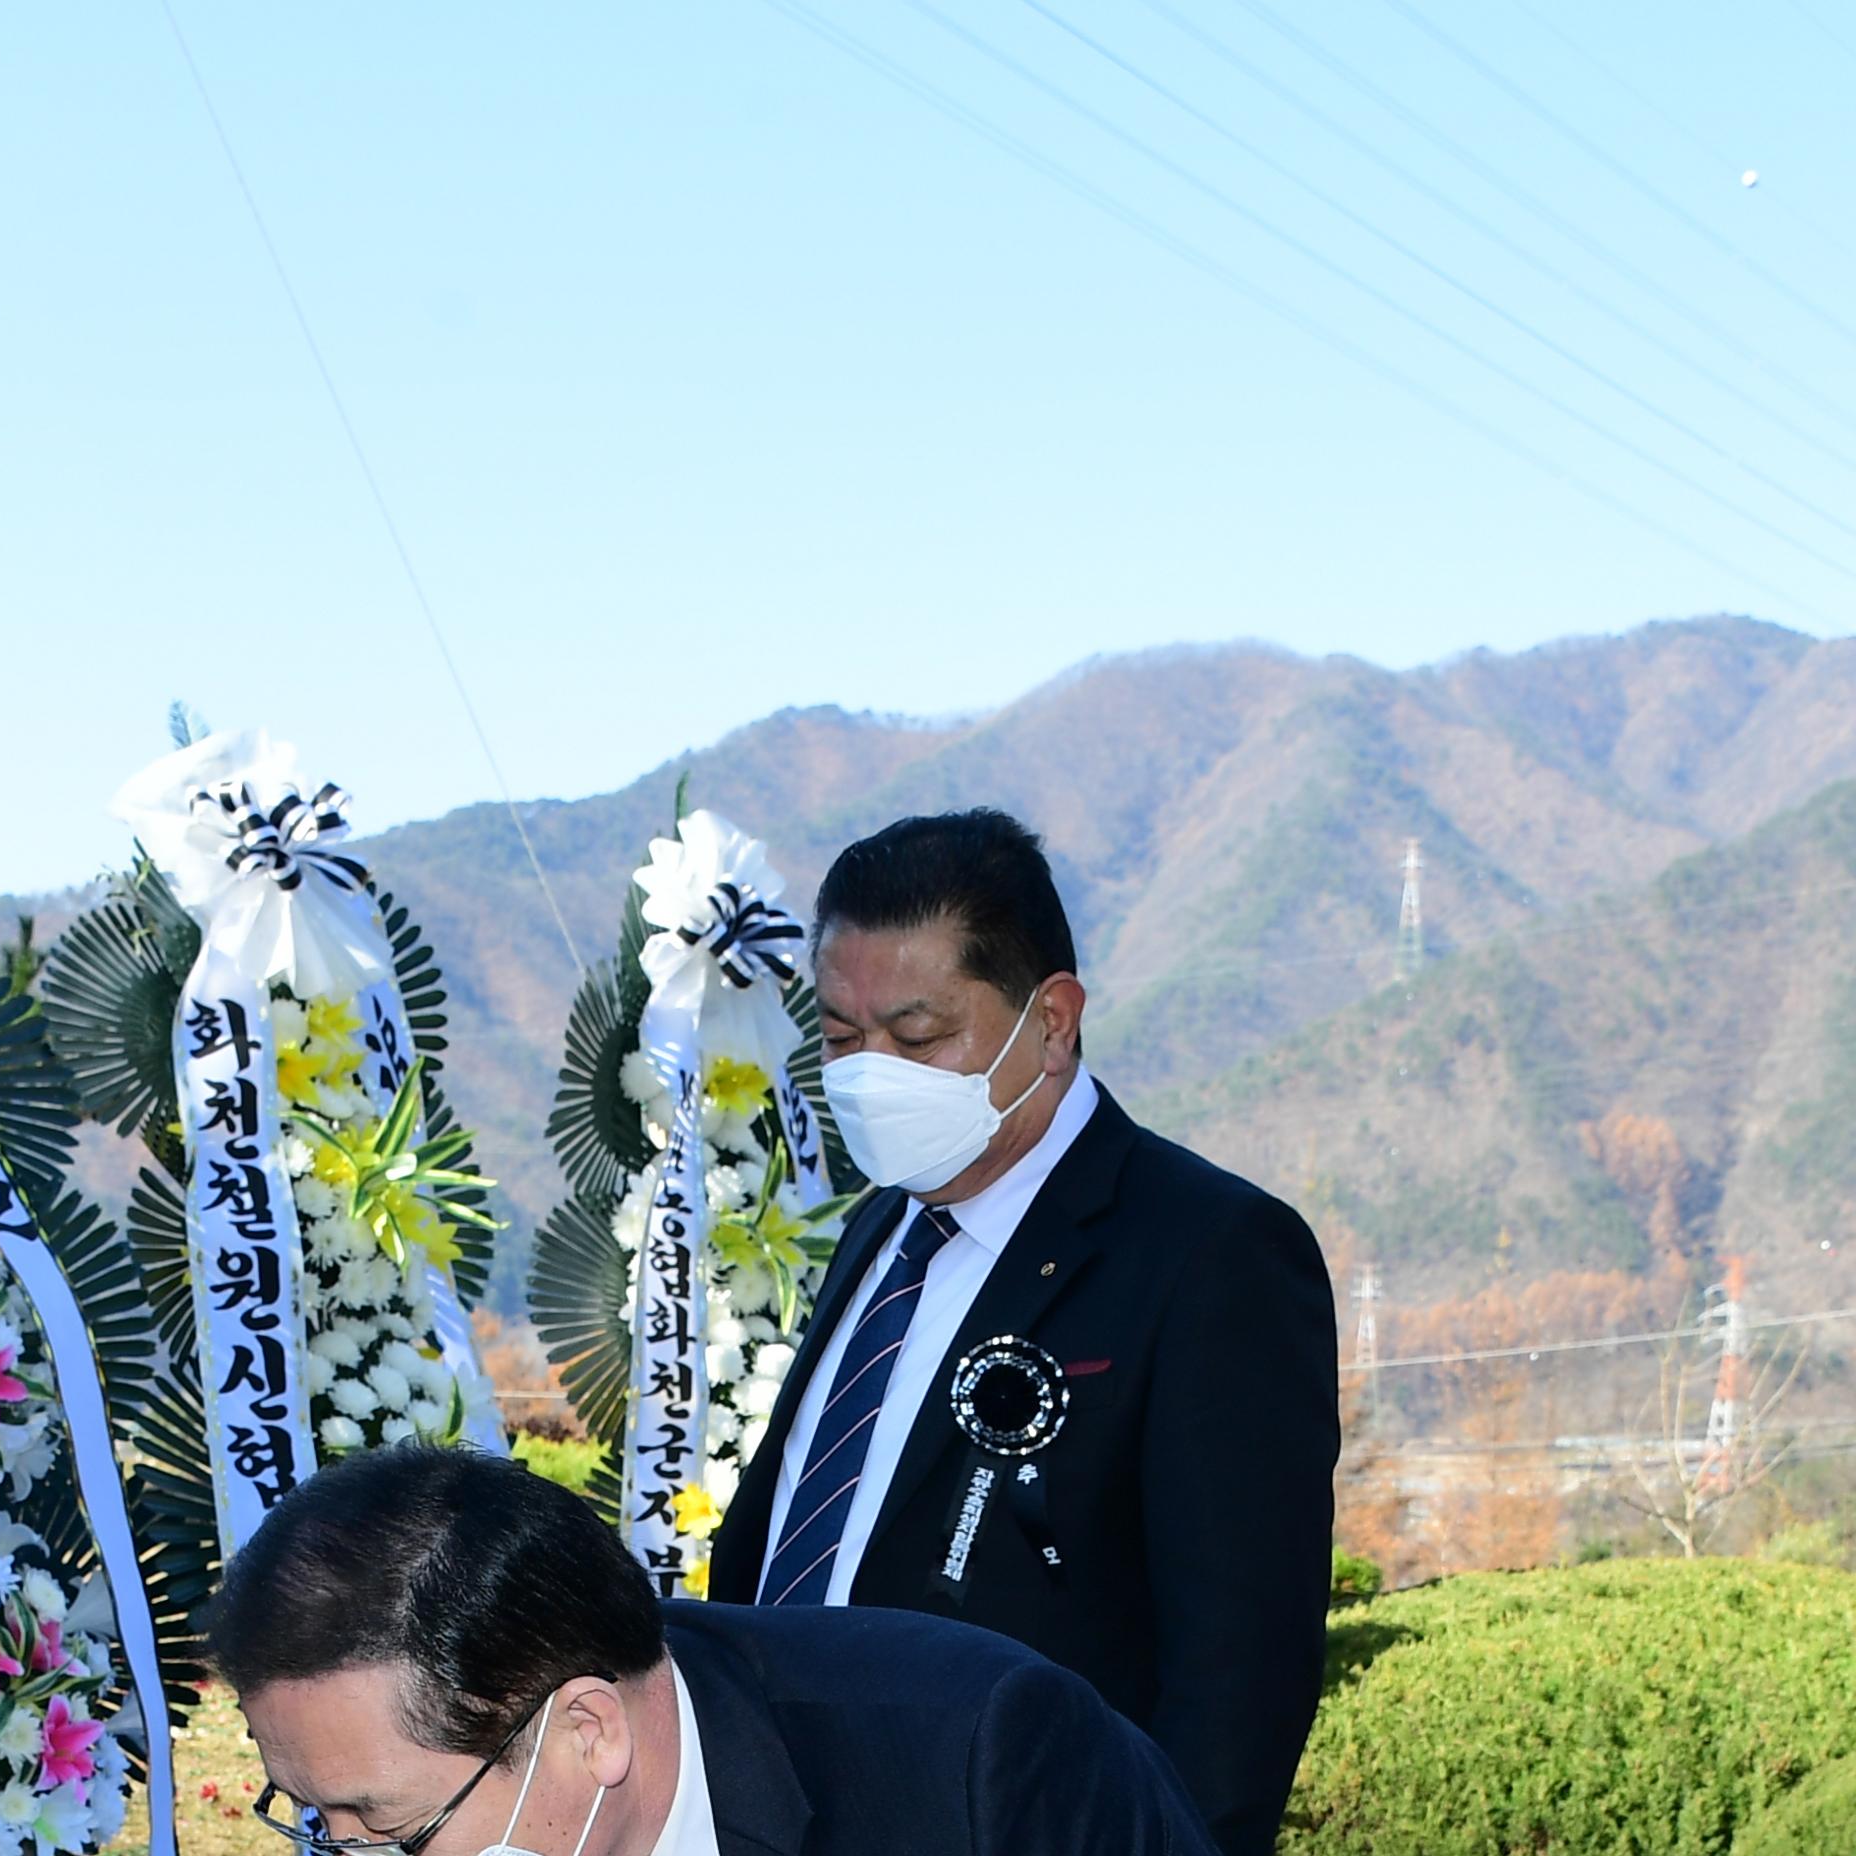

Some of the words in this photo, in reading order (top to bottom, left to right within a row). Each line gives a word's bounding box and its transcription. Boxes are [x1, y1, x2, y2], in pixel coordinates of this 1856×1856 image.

[185, 999, 296, 1509] 화천철원신협
[1016, 1463, 1039, 1484] 추
[1042, 1546, 1061, 1565] 모
